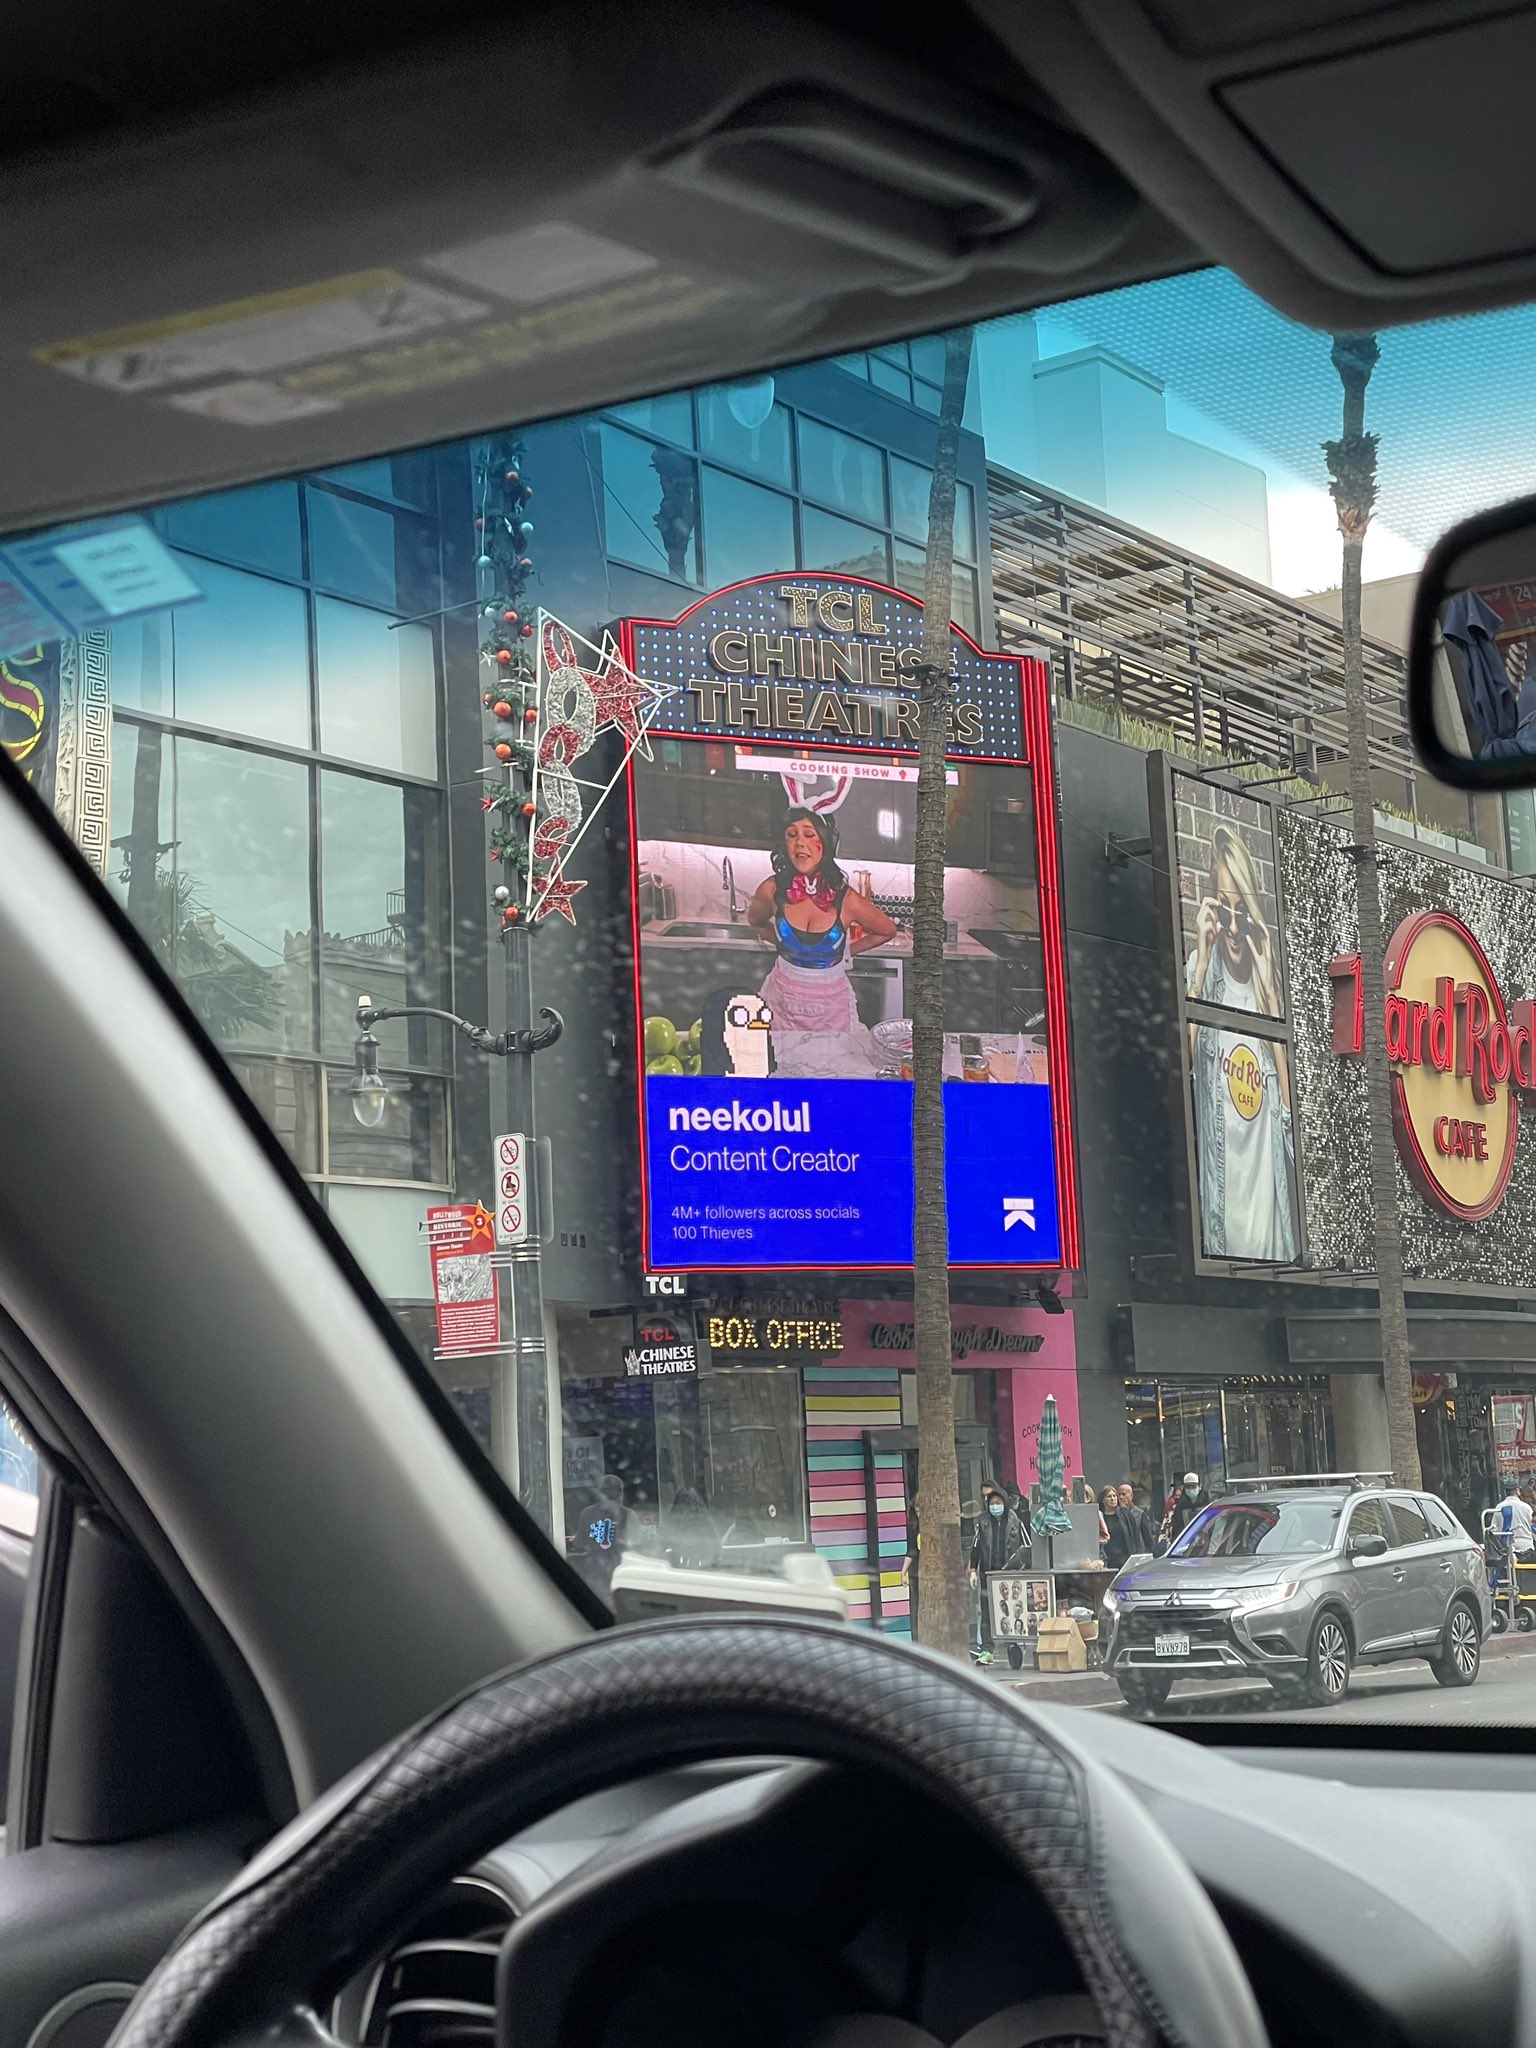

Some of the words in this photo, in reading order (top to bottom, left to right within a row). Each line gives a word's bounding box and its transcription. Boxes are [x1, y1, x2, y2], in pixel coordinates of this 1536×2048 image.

[779, 585, 887, 636] TCL
[709, 631, 957, 694] CHINES
[790, 763, 848, 775] COOKING
[854, 767, 890, 778] SHOW
[1237, 1092, 1255, 1108] CAFE
[669, 1100, 811, 1133] neekolul
[1433, 1115, 1489, 1161] CAFE
[670, 1145, 768, 1172] Content
[772, 1145, 860, 1172] Creator
[671, 1206, 701, 1220] 4M+
[705, 1206, 766, 1219] followers
[769, 1207, 812, 1219] across
[815, 1206, 860, 1219] socials
[433, 1222, 463, 1231] HISTORIC
[476, 1217, 483, 1226] 3
[673, 1226, 697, 1240] 100
[700, 1226, 754, 1240] Thieves
[645, 1276, 685, 1294] TCL
[640, 1327, 675, 1343] TCL
[709, 1317, 759, 1349] BOX
[766, 1318, 844, 1350] OFFICE
[640, 1346, 695, 1362] CHINESE
[641, 1360, 697, 1375] THEATRES
